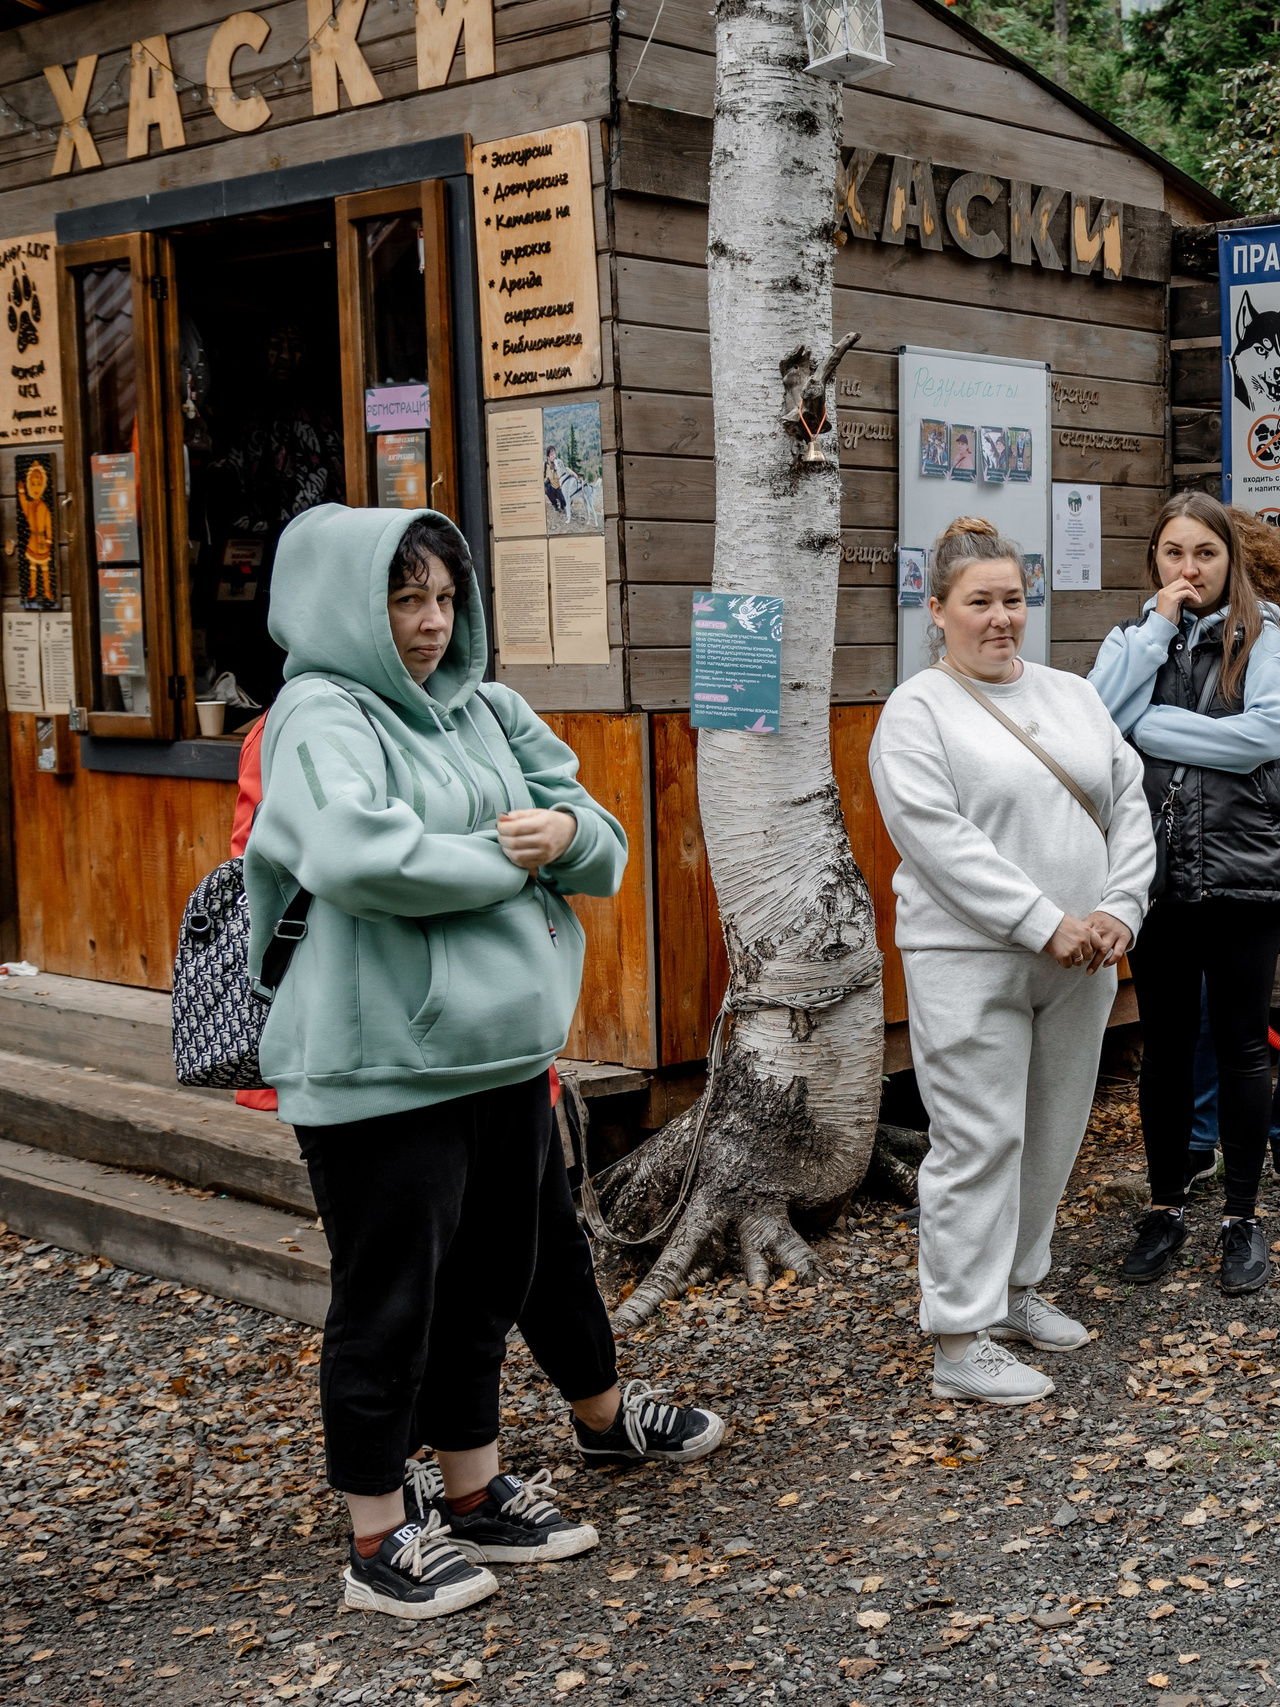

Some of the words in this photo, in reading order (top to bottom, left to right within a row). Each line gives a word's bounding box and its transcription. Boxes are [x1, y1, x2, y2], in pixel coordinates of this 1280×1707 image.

[43, 0, 496, 176] ХАСКИ
[491, 144, 552, 168] Экскурсии
[496, 208, 552, 231] Катание
[556, 205, 571, 219] на
[501, 241, 551, 266] упряжке
[499, 271, 543, 297] Аренда
[504, 301, 574, 327] снаряжения
[504, 366, 572, 387] Хаски-шоп
[914, 367, 1018, 407] Результаты
[366, 401, 430, 416] РЕГИСТРАЦИЯ
[1243, 475, 1273, 484] входить
